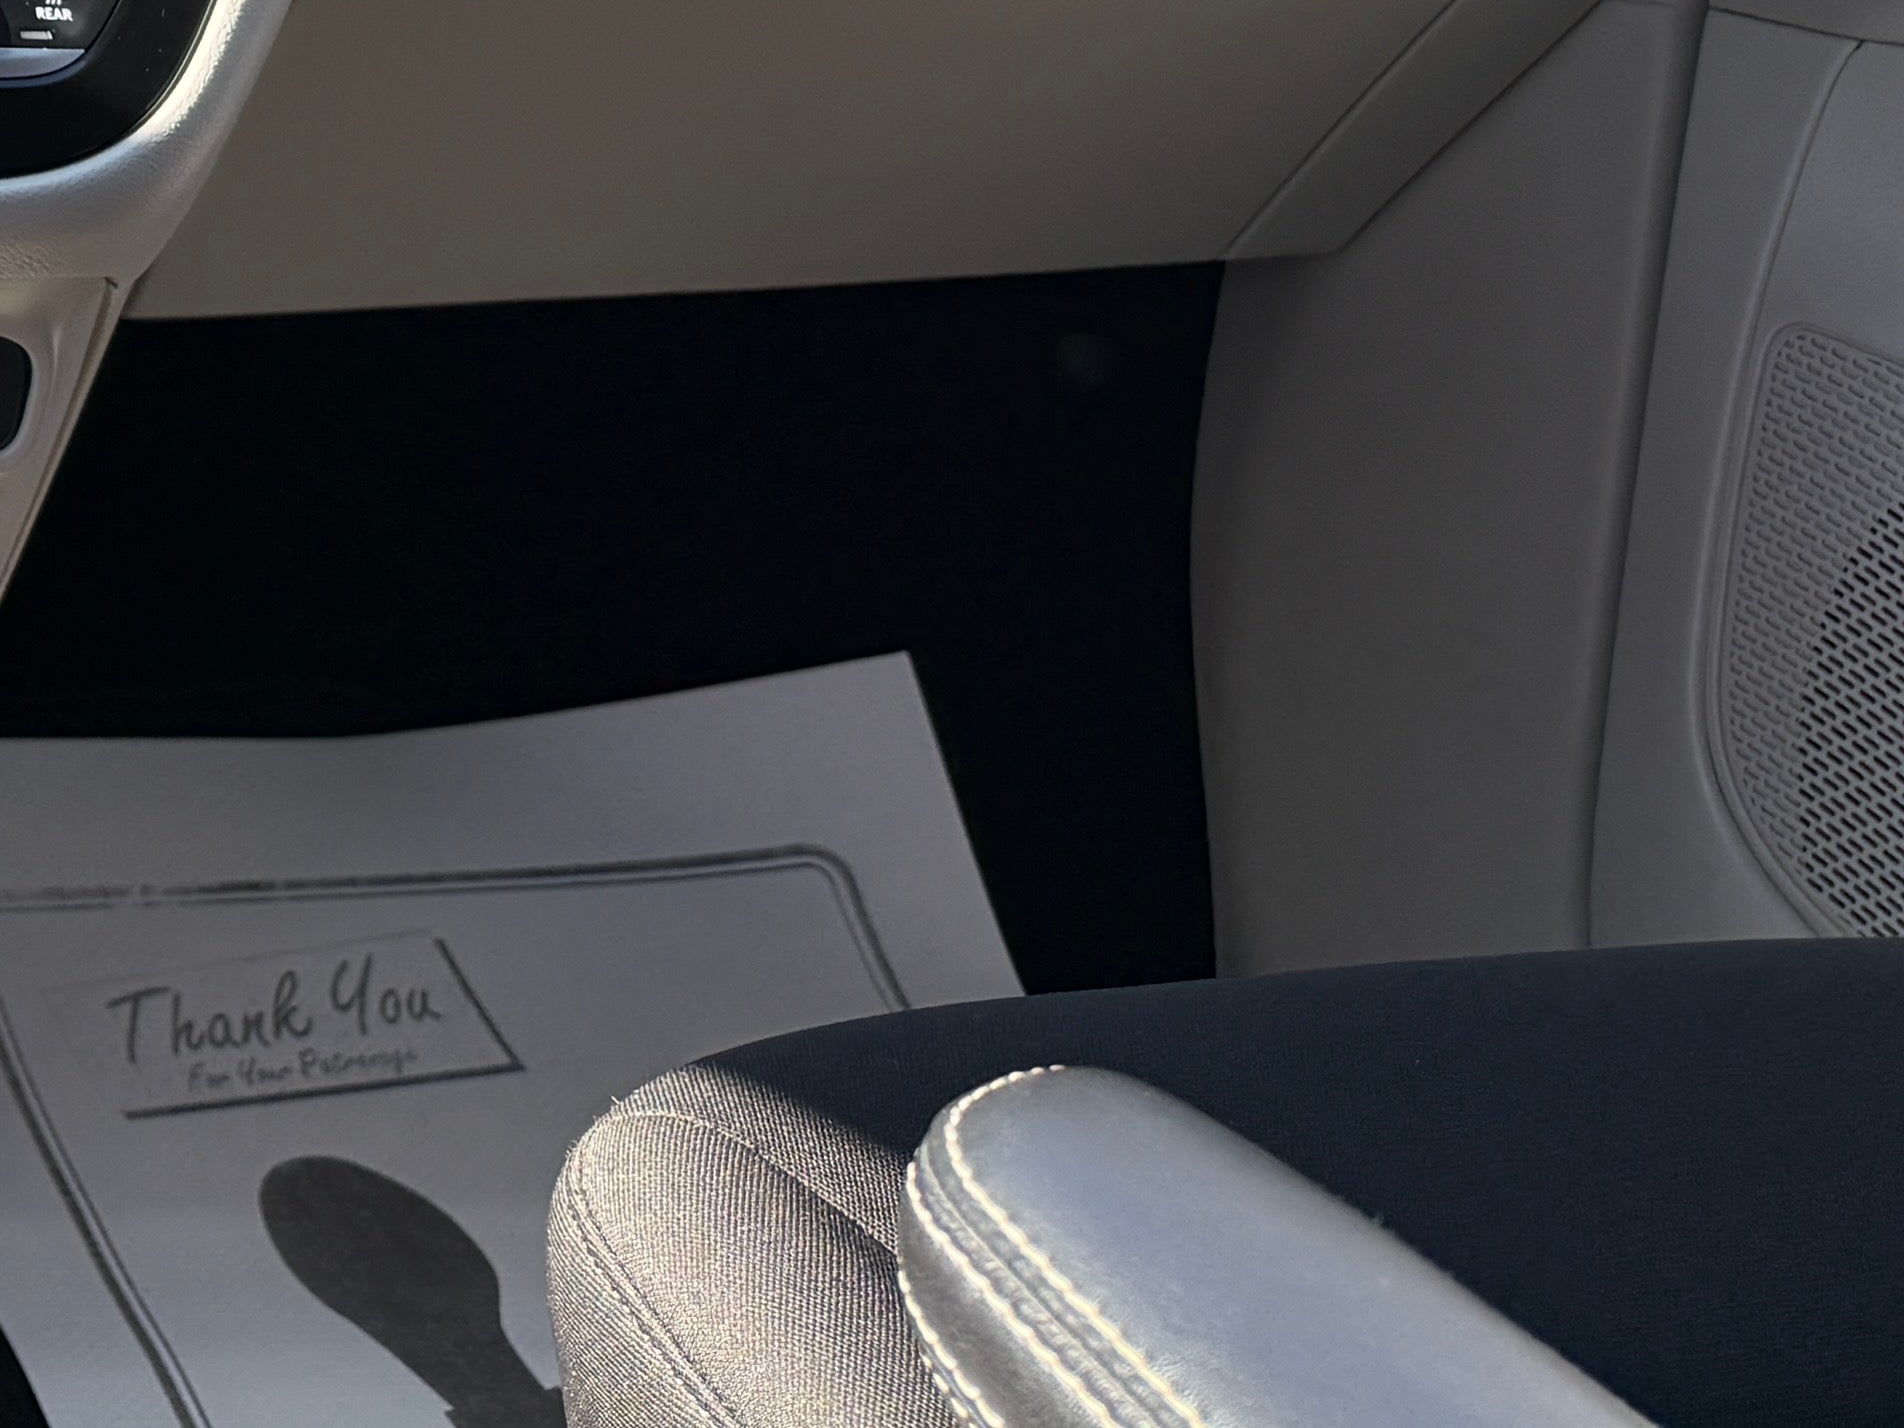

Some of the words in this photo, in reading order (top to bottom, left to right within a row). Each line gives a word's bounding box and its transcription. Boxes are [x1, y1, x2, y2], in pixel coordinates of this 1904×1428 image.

[35, 5, 73, 22] REAR
[105, 970, 313, 1064] Thank
[331, 952, 442, 1036] You
